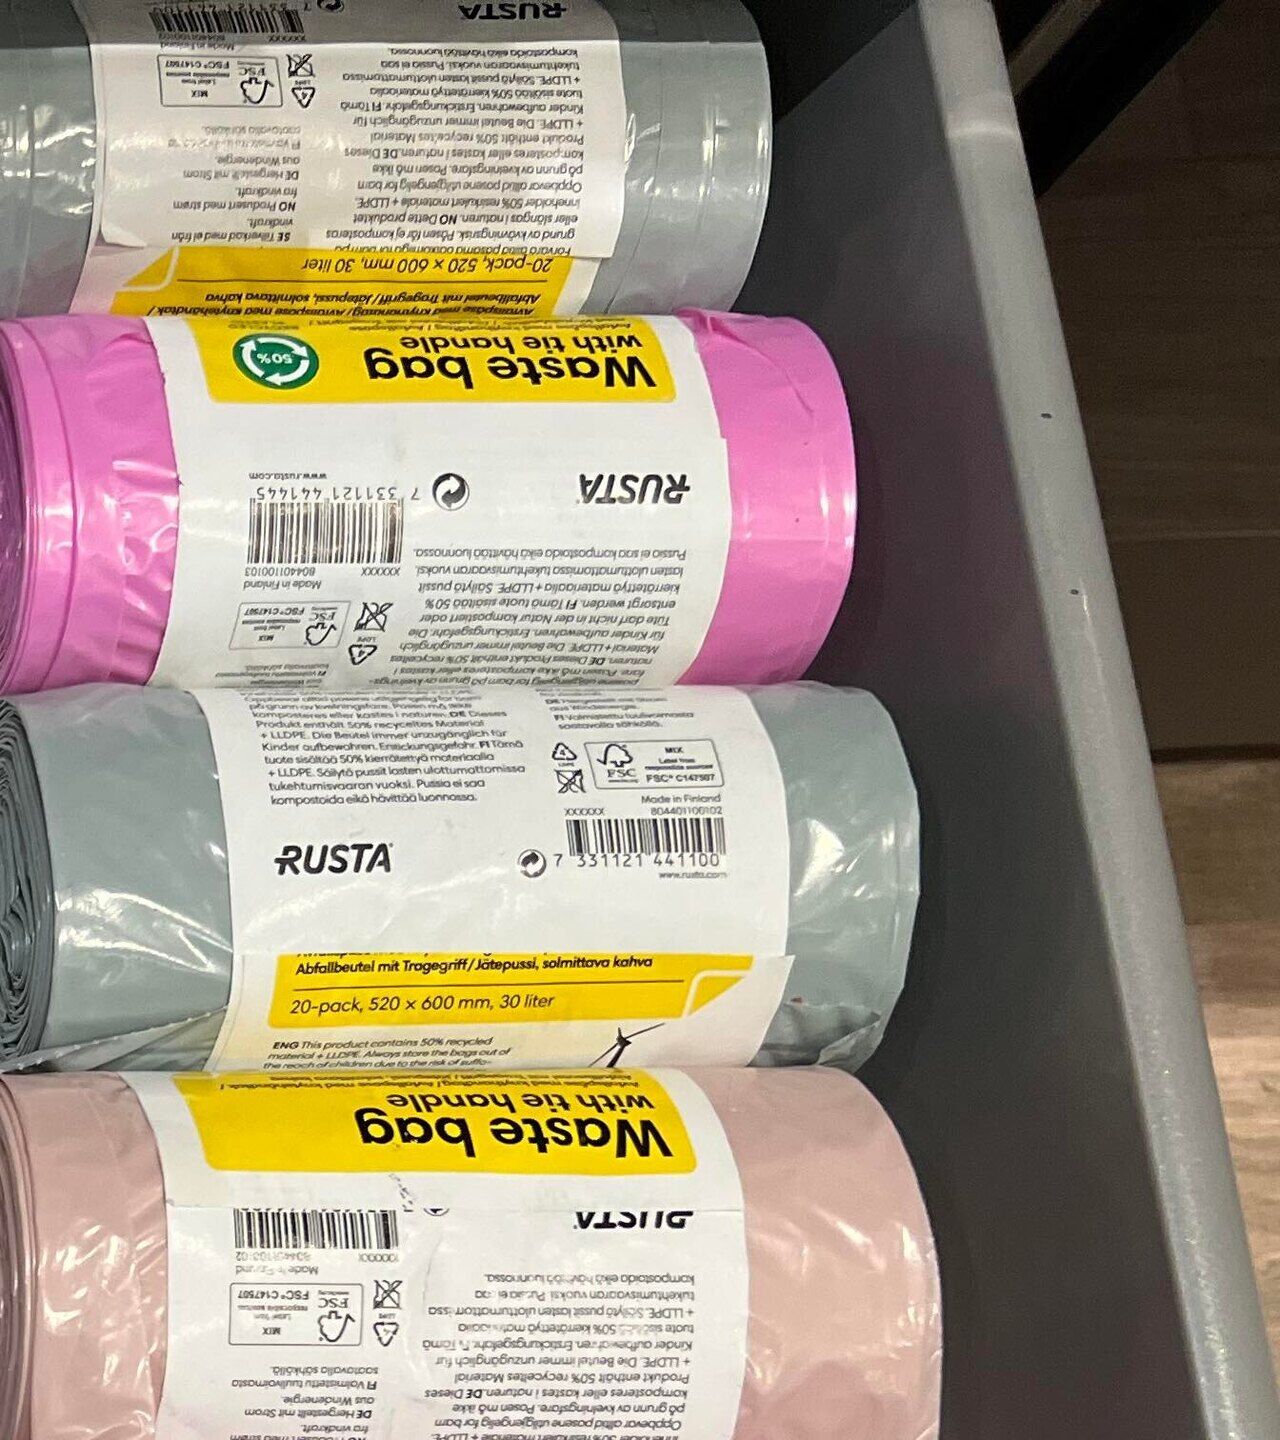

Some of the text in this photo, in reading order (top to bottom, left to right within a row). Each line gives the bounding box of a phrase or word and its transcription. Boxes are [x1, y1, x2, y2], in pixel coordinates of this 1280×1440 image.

[458, 2, 567, 19] RUSTA
[301, 259, 332, 273] liter
[335, 259, 355, 273] 30
[361, 258, 394, 269] mm,
[397, 259, 429, 273] 600
[448, 258, 478, 273] 520
[483, 256, 554, 273] 20-pack,
[400, 335, 642, 353] with tie handle
[256, 353, 294, 364] 50%
[364, 348, 656, 389] Waste bag
[254, 487, 322, 500] 441445
[333, 487, 398, 500] 331121
[578, 474, 690, 504] RUSTA
[243, 581, 280, 590] Finland
[292, 580, 322, 589] Made
[274, 844, 393, 874] RUSTA
[576, 853, 642, 867] 331121
[652, 852, 722, 866] 441100
[296, 961, 375, 974] Abfallbeutel
[378, 960, 400, 972] mit
[542, 957, 610, 968] solmittava
[613, 956, 652, 967] kahva
[290, 998, 363, 1016] 20-pack,
[368, 996, 400, 1010] 520
[422, 996, 454, 1010] 600
[458, 999, 493, 1010] mm,
[500, 994, 520, 1009] 30
[524, 994, 554, 1007] liter
[385, 1094, 654, 1113] with tie handle
[354, 1107, 673, 1158] Waste bag
